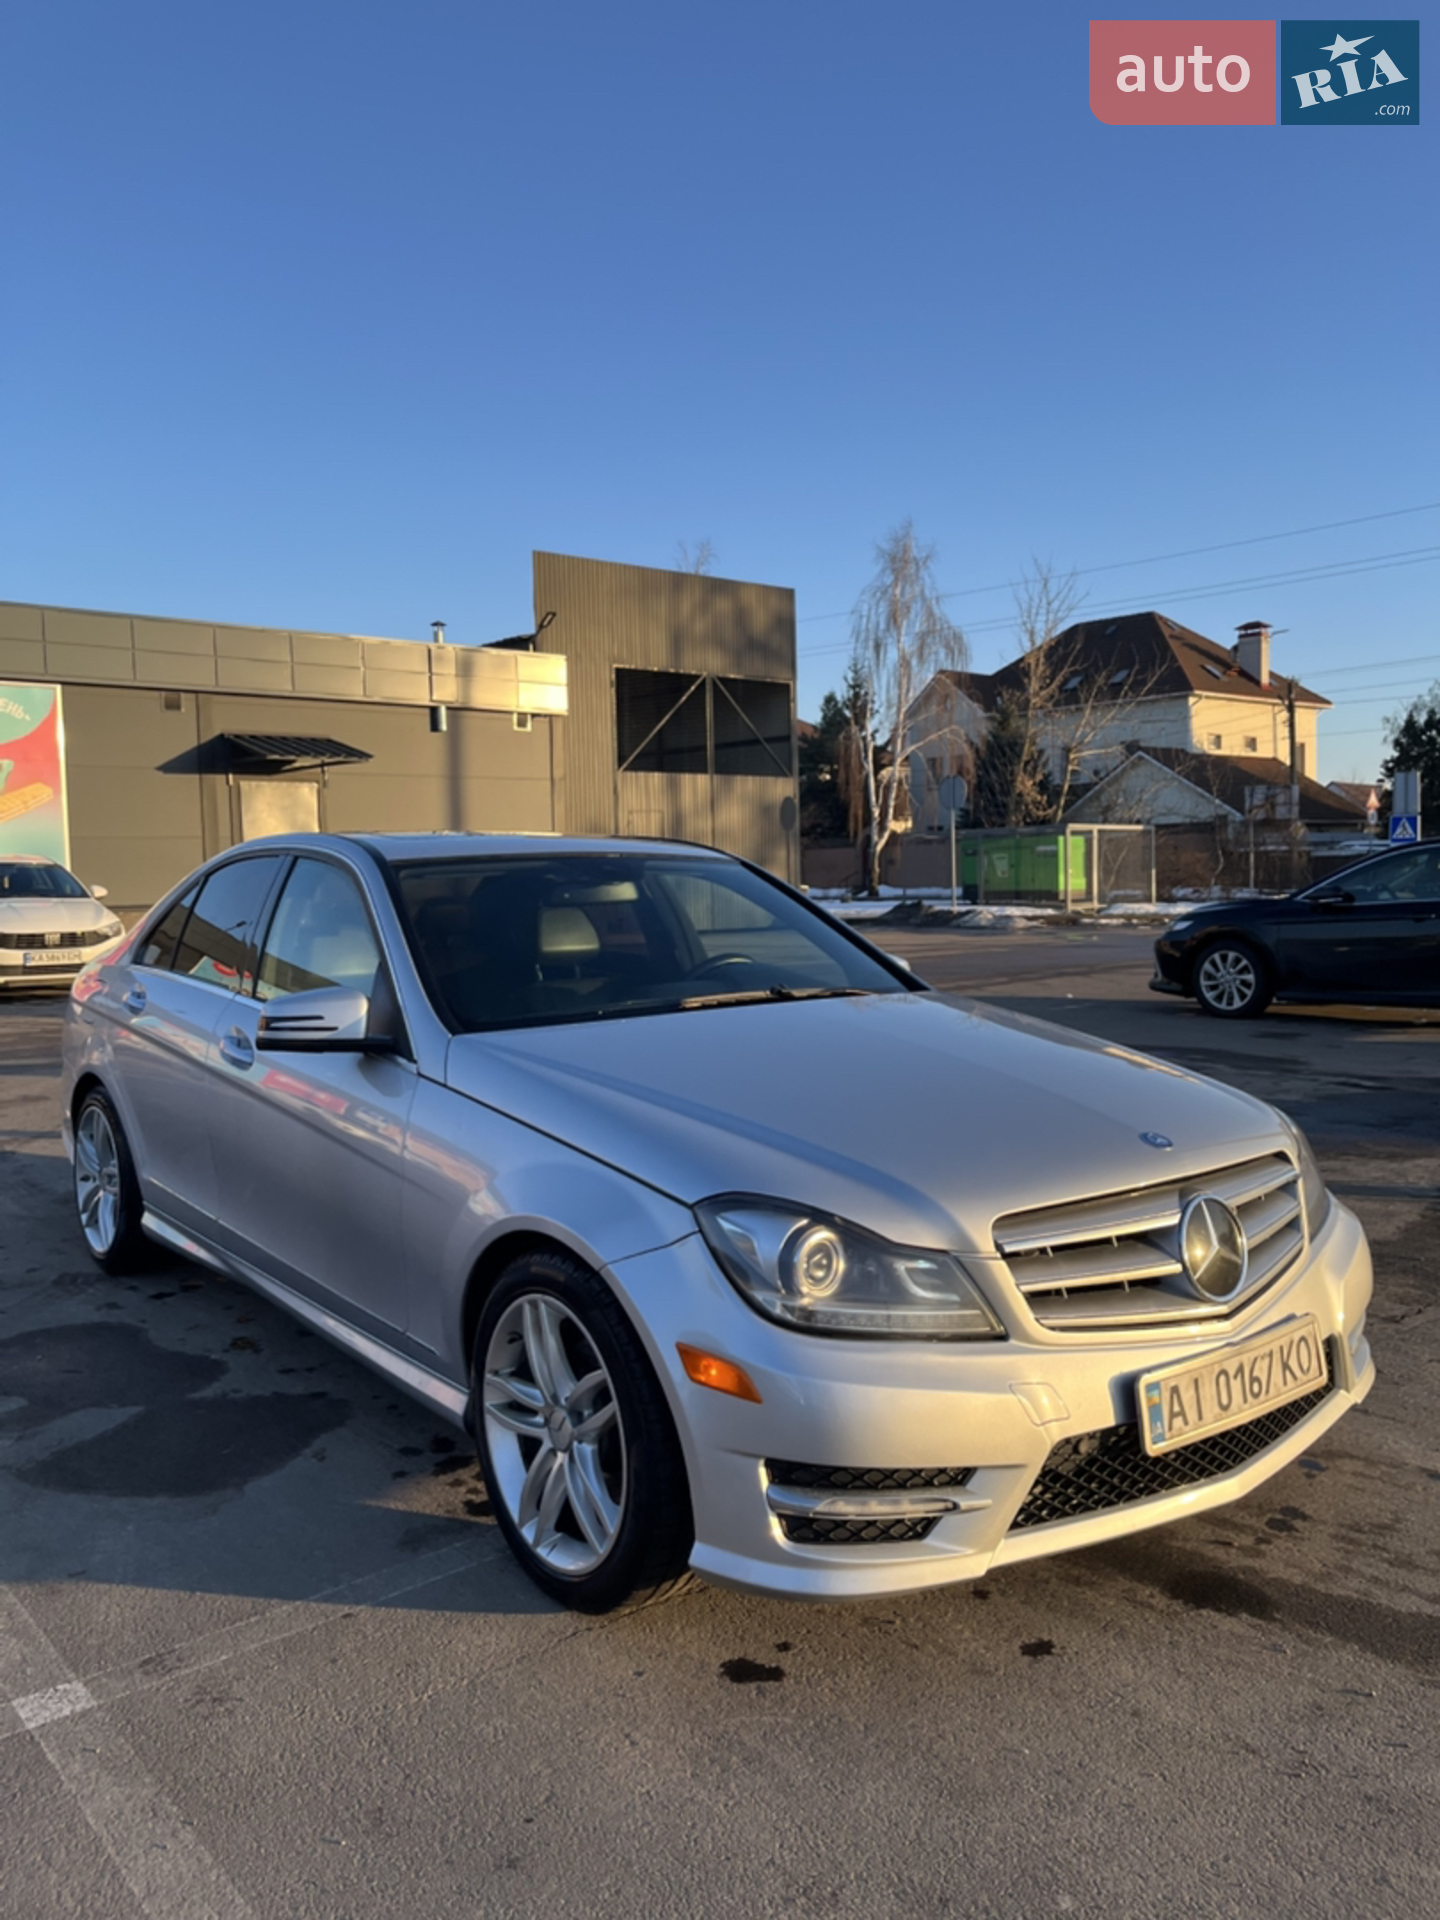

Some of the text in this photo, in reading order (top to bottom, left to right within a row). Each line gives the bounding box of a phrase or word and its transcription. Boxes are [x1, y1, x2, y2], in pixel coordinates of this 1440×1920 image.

[1168, 1335, 1312, 1431] AI 0167 KO
